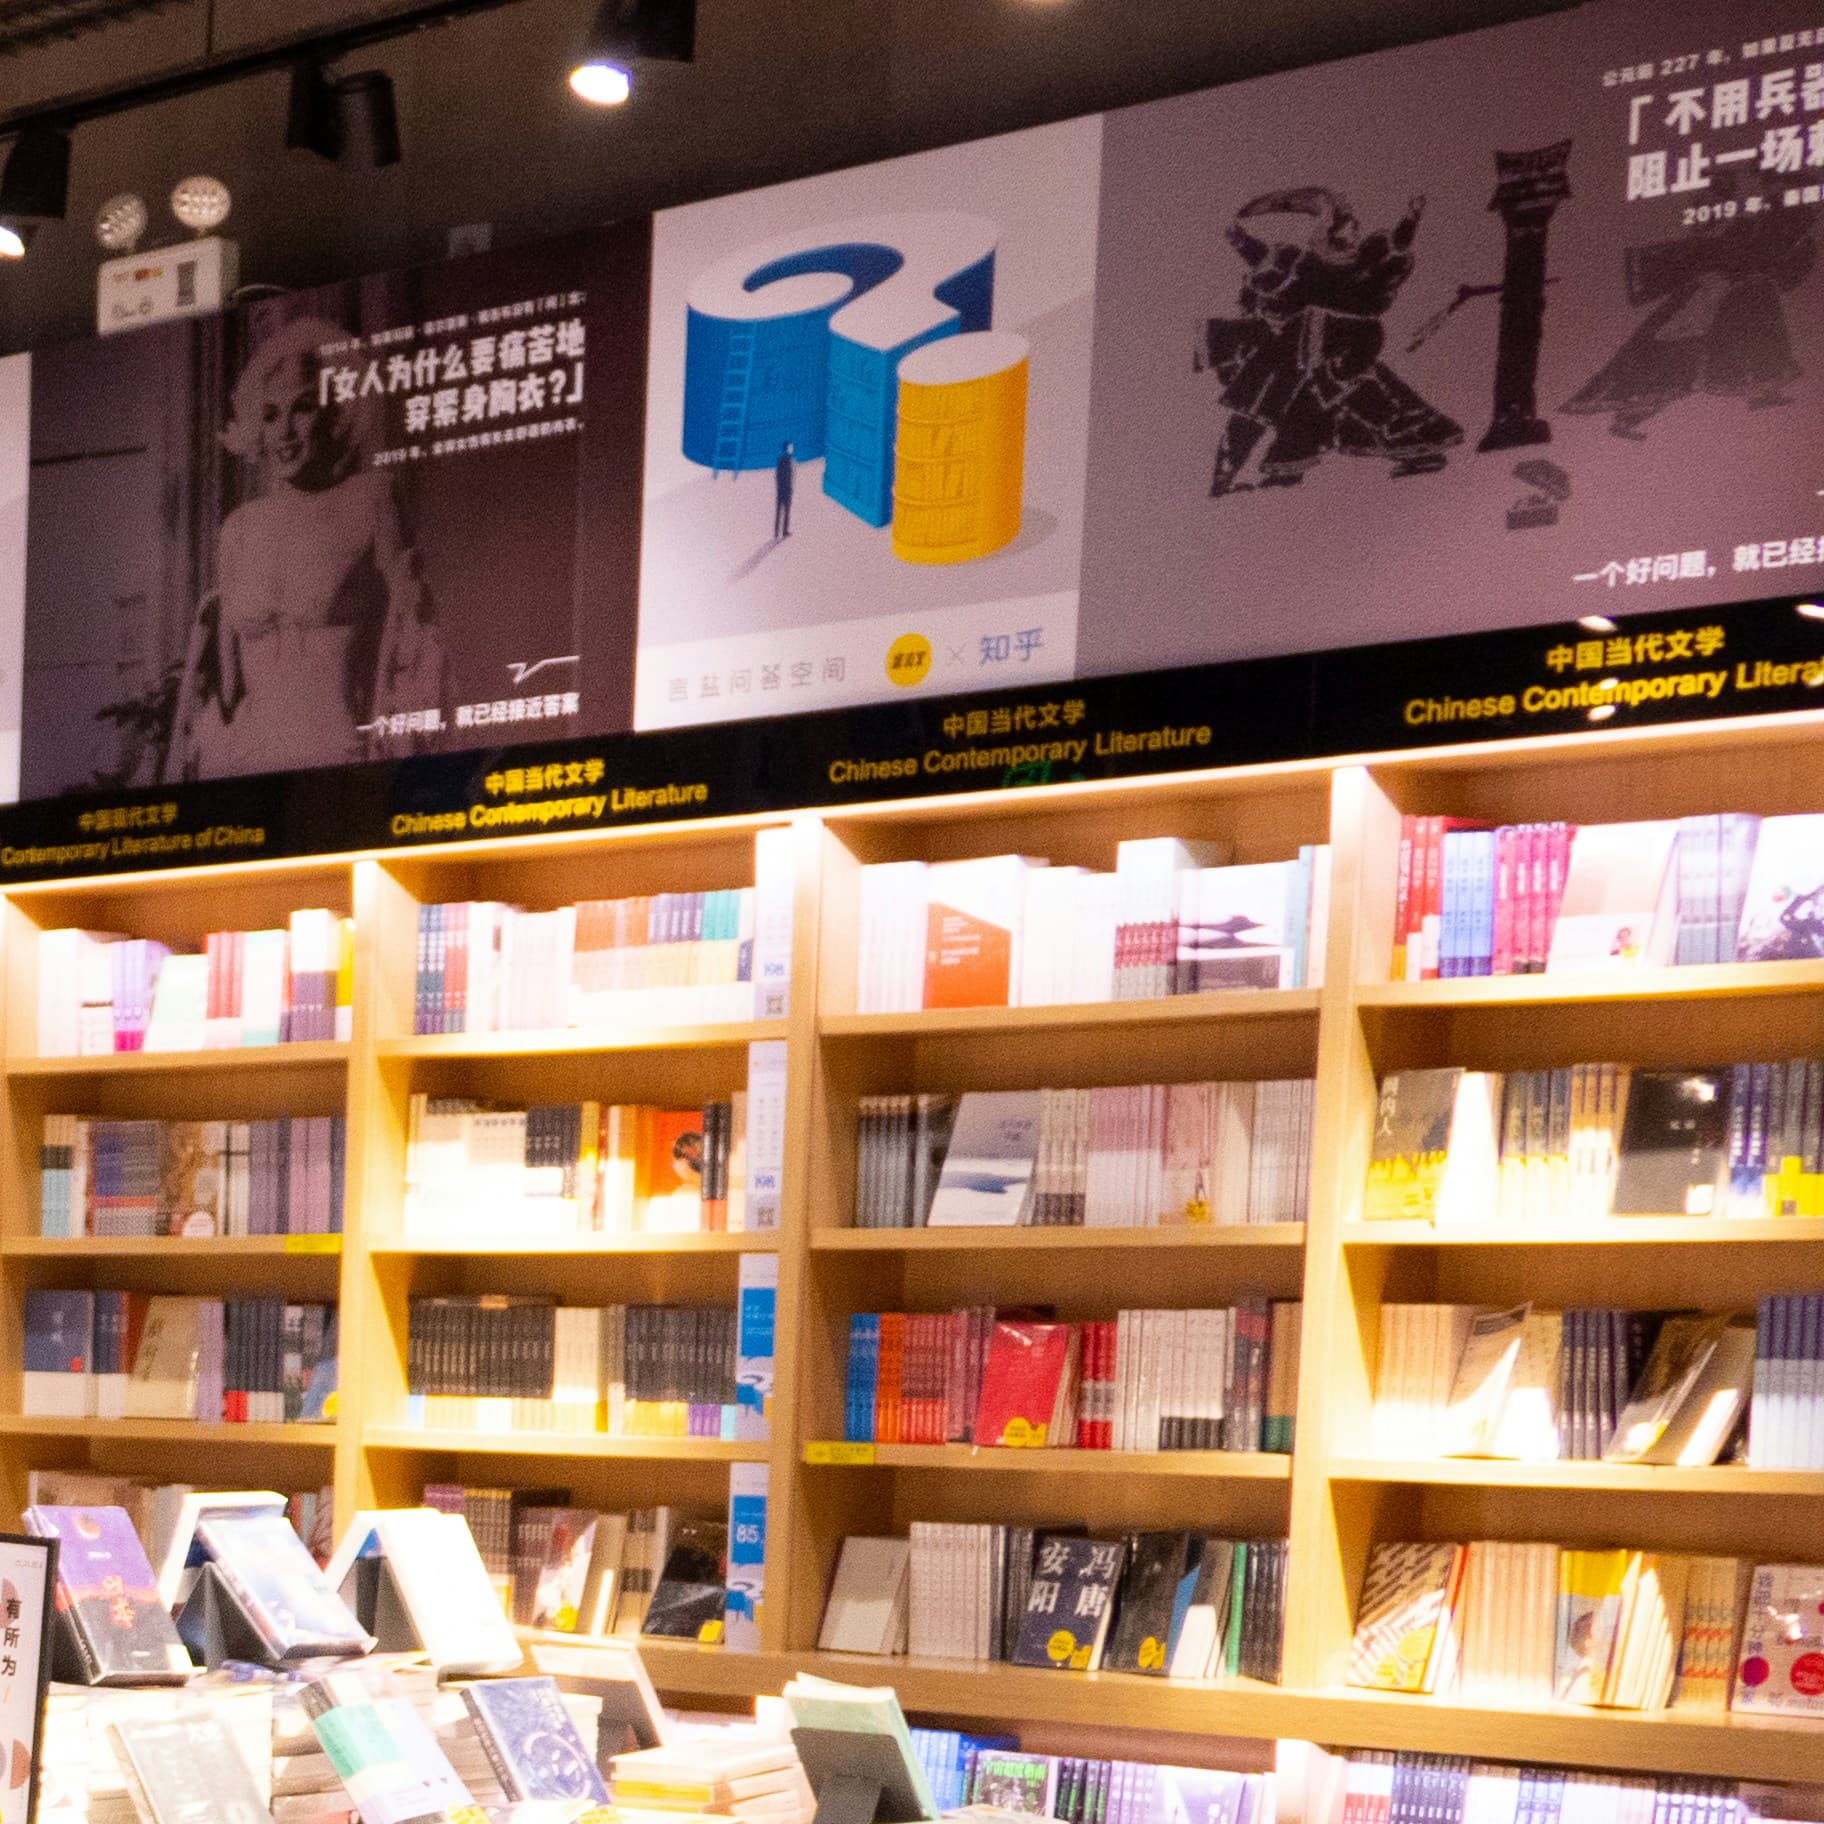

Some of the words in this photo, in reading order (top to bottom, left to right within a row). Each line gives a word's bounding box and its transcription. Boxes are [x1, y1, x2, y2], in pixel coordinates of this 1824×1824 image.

[1660, 53, 1699, 76] 227
[1683, 200, 1738, 226] 2019
[319, 317, 586, 407] 「女人为什么要痛苦地
[979, 627, 1045, 666] 知乎
[1547, 625, 1726, 674] 中国当代文学
[943, 699, 1087, 740] 中国当代文学
[1405, 693, 1516, 727] Chinese
[1522, 668, 1728, 716] Contemporary
[484, 758, 607, 797] 中国当代文学
[828, 754, 918, 785] Chinese
[922, 737, 1087, 777] Contemporary
[1094, 723, 1212, 757] Literature
[391, 808, 467, 838] Chinese
[468, 794, 609, 830] Contemporary
[610, 780, 709, 811] Literature
[111, 831, 194, 860] Literature
[195, 828, 213, 850] of
[214, 824, 266, 849] China
[1027, 1541, 1070, 1615] 安阳
[1074, 1545, 1117, 1618] 冯唐
[1, 1598, 21, 1678] 有所为
